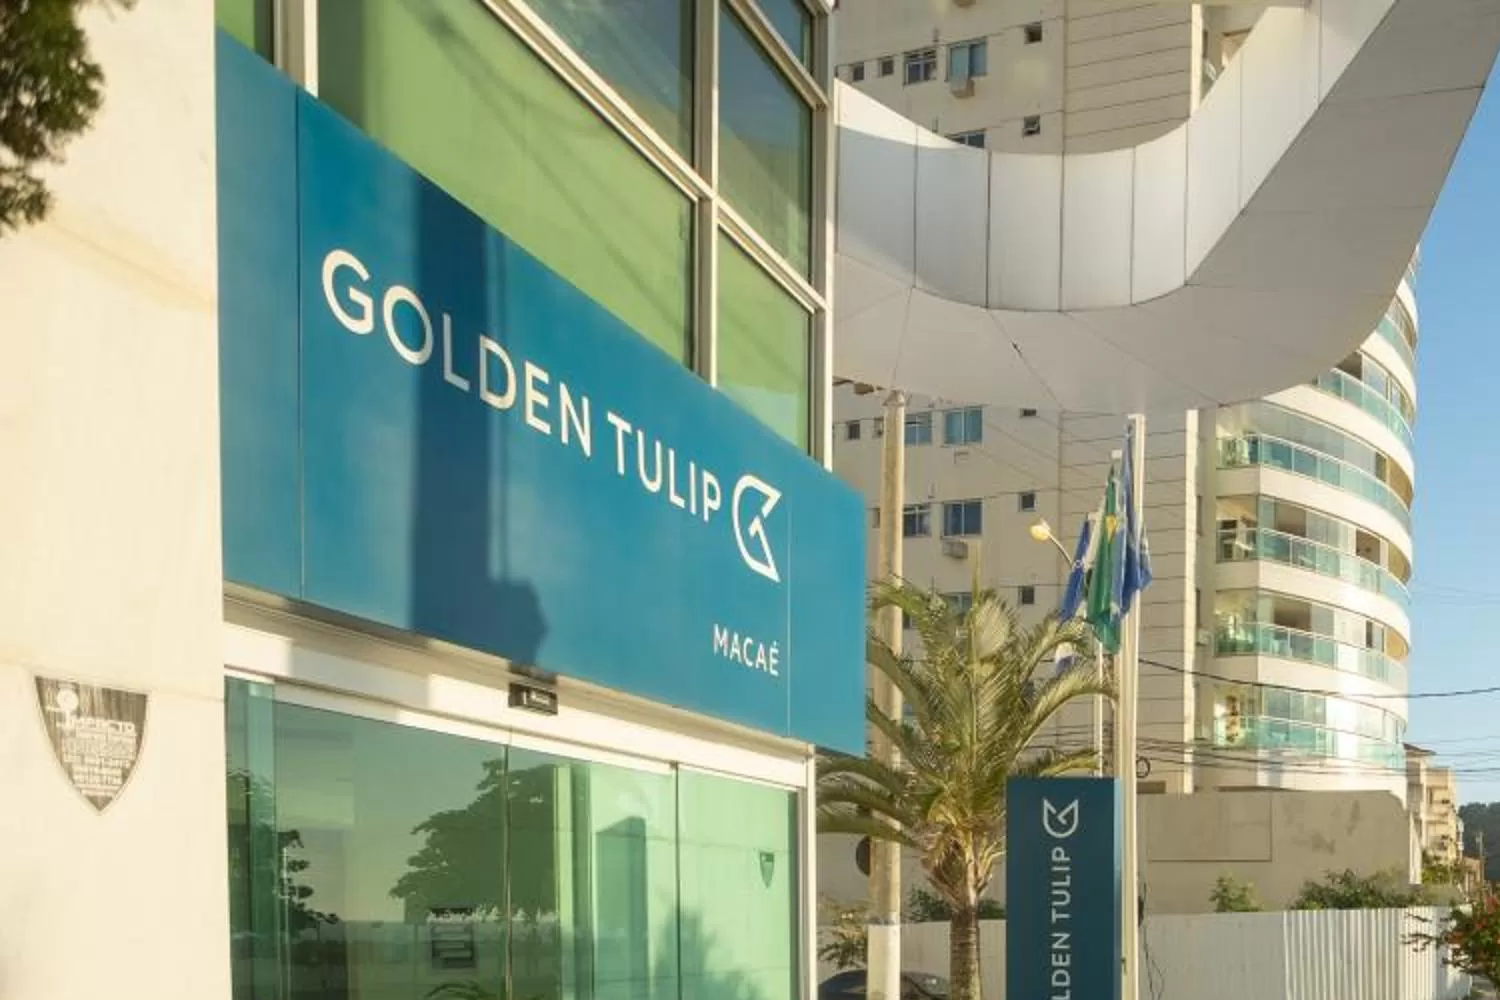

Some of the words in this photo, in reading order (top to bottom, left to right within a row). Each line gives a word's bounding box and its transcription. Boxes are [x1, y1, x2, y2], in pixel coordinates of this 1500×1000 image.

[321, 249, 591, 457] GOLDEN
[606, 411, 722, 522] TULIP
[713, 623, 780, 677] MACAÉ
[1051, 846, 1071, 923] TULIP
